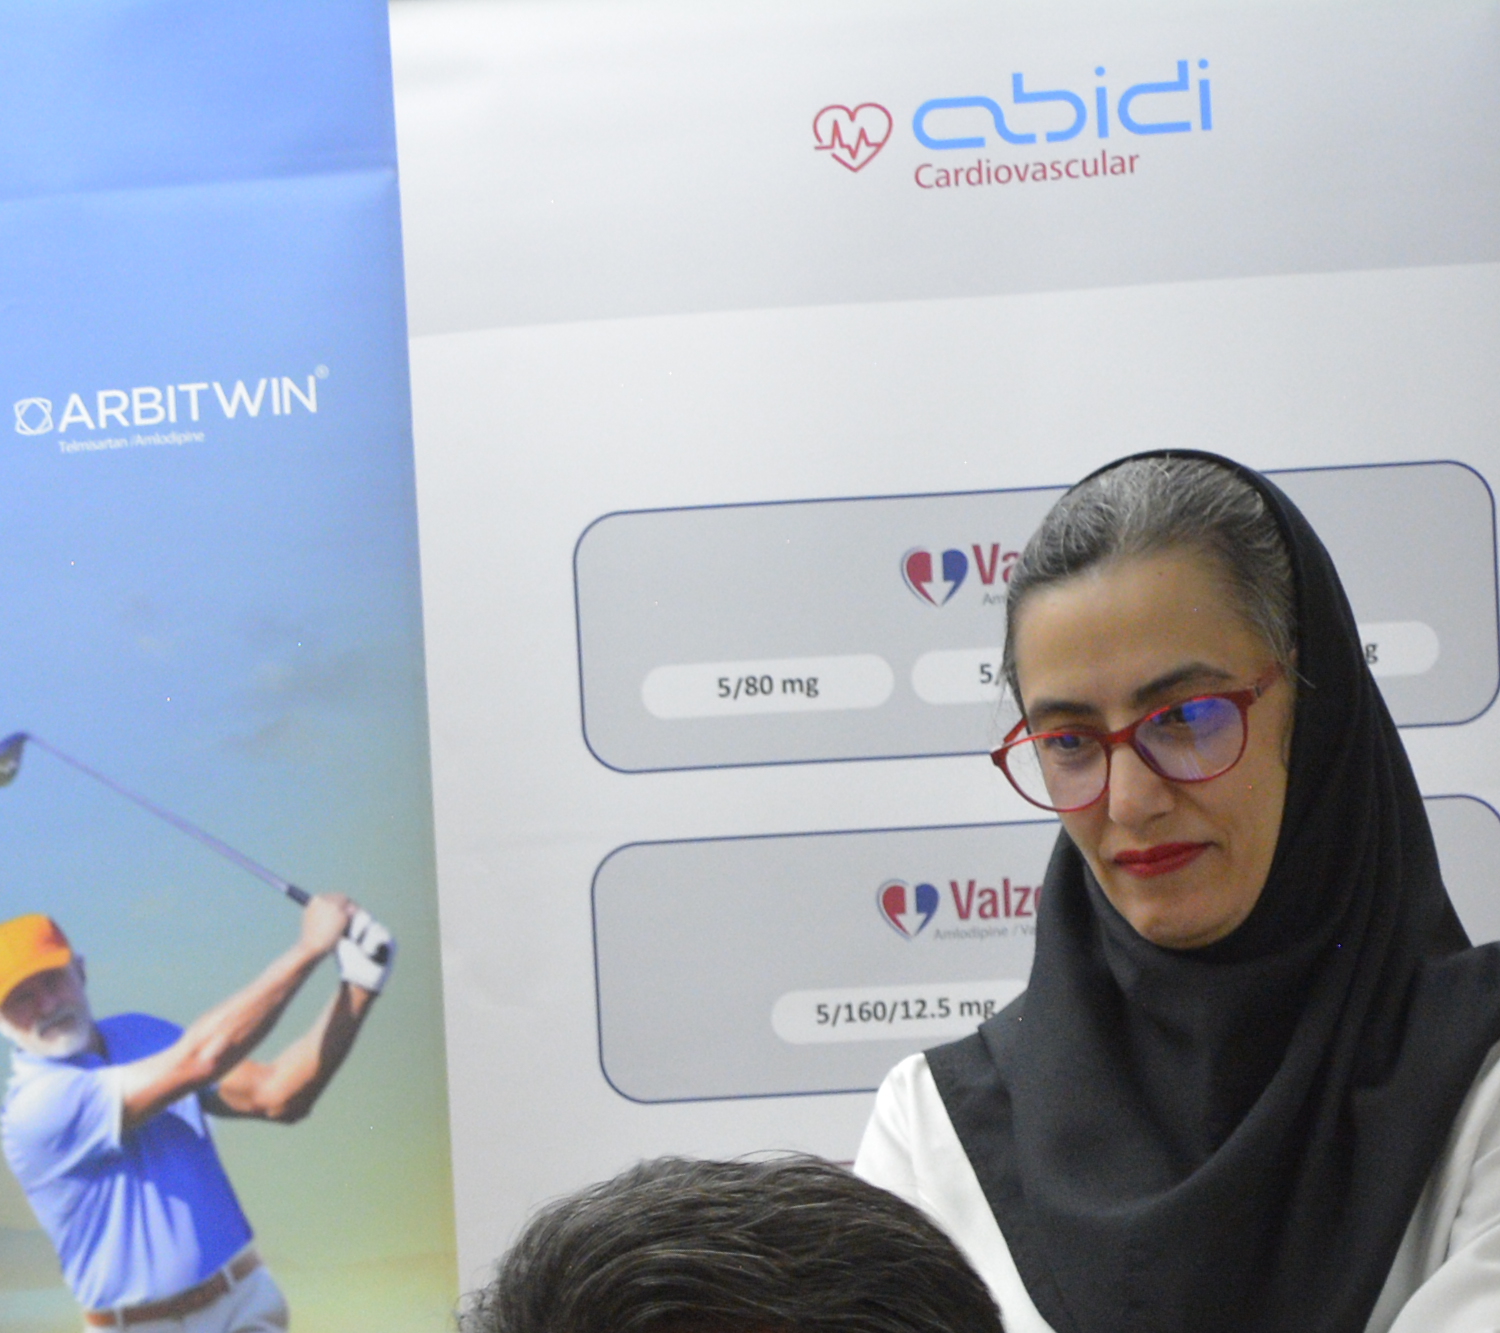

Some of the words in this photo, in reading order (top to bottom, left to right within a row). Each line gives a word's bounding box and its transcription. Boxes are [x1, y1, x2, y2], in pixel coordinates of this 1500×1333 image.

[912, 58, 1213, 151] abidi
[914, 148, 1140, 190] Cardiovascular
[717, 674, 775, 701] 5/80
[782, 676, 820, 698] mg
[816, 998, 952, 1028] 5/160/12.5
[959, 997, 997, 1019] mg
